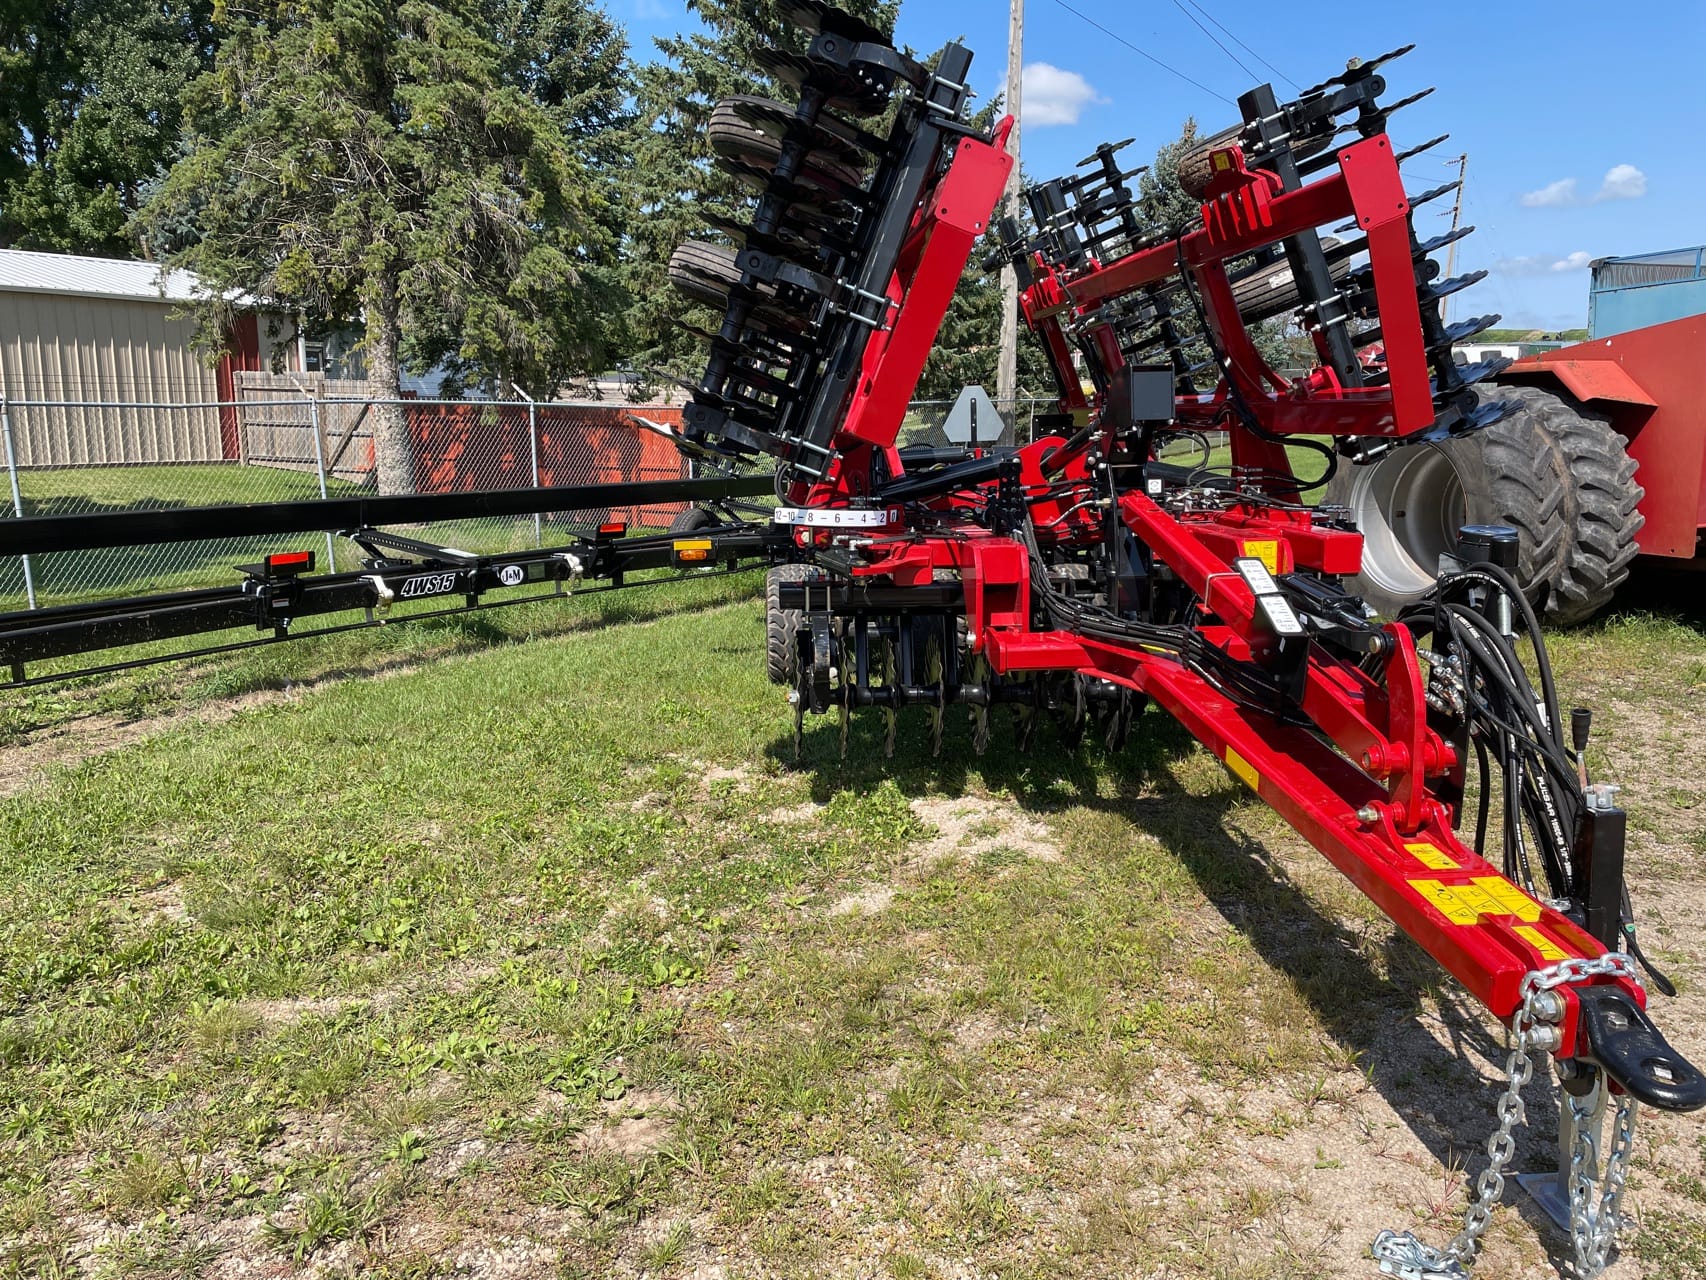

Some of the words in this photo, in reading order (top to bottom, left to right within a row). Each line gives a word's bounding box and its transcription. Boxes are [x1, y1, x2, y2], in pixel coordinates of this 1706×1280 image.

[400, 573, 456, 597] 4WS15
[503, 568, 521, 583] J&M
[1537, 776, 1555, 816] PULSAR
